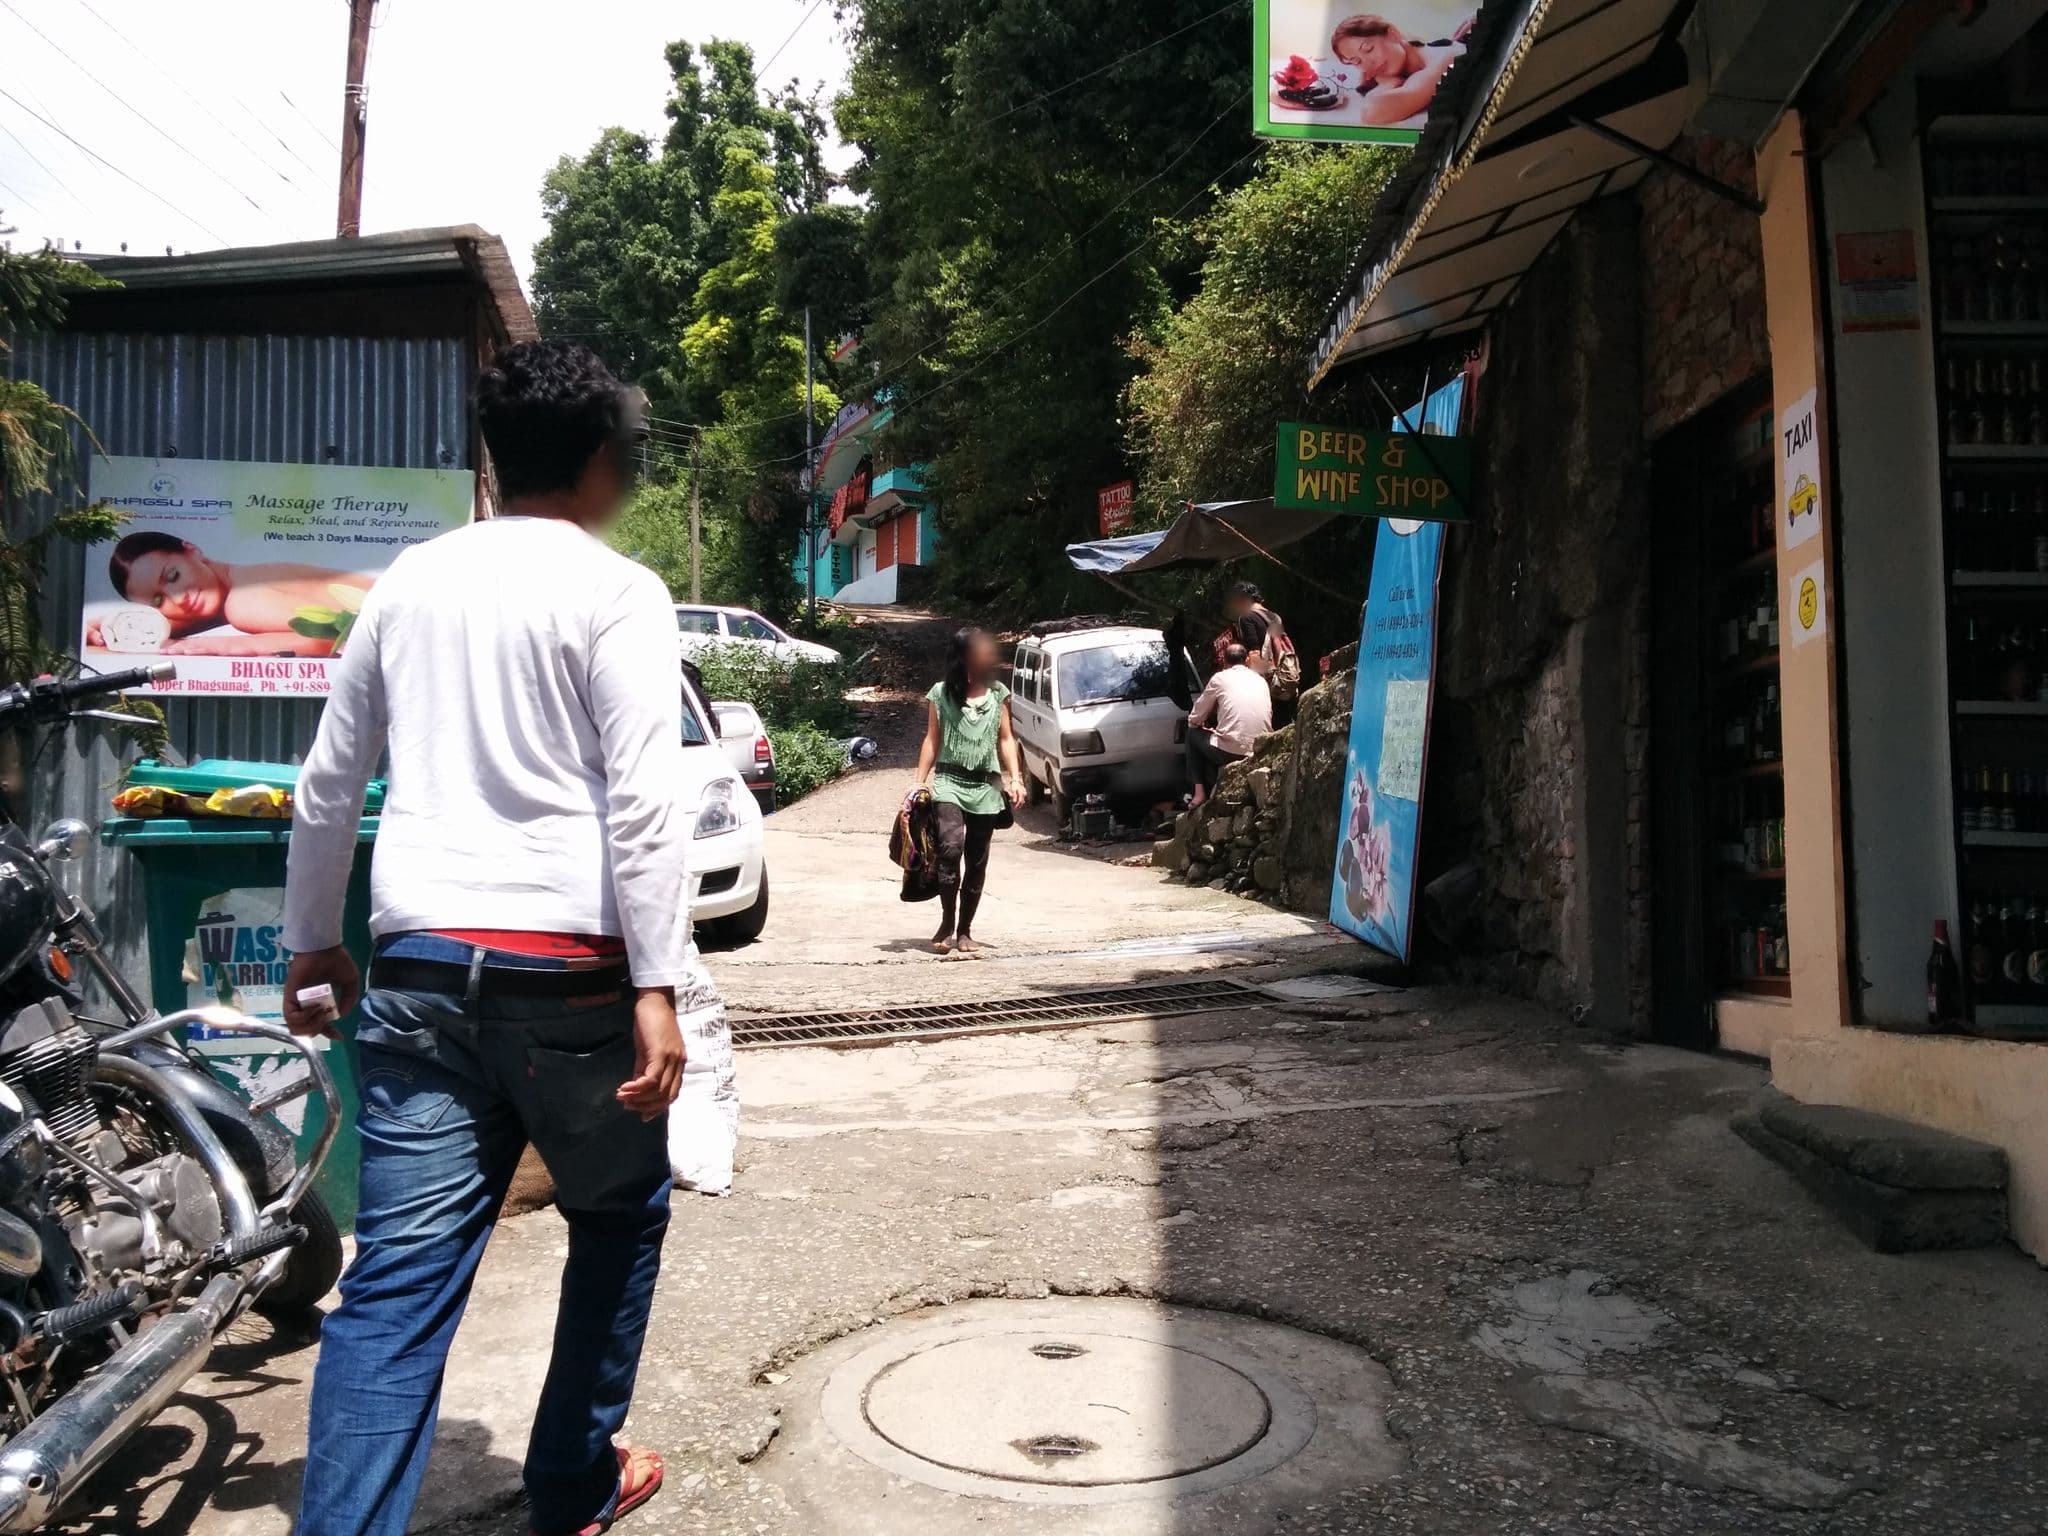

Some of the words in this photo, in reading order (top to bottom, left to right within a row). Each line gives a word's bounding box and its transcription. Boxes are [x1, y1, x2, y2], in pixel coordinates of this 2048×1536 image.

[1784, 411, 1811, 458] TAXI
[1298, 429, 1367, 467] BEER
[1382, 436, 1407, 468] &
[1099, 485, 1131, 507] TATTOO
[1296, 467, 1361, 503] WINE
[1375, 474, 1450, 509] SHOP
[191, 499, 232, 508] SPA
[246, 494, 325, 514] Massage
[331, 496, 408, 517] Therapy
[268, 515, 305, 525] Relax,
[309, 516, 340, 526] Heal,
[343, 516, 366, 527] and
[264, 532, 284, 541] (We
[286, 532, 314, 541] teach
[318, 534, 324, 542] 3
[326, 534, 351, 544] Days
[354, 535, 398, 545] Massage
[230, 661, 293, 679] BHAGSU
[298, 663, 326, 679] SPA
[260, 681, 279, 692] Ph.
[284, 681, 332, 693] +91-889
